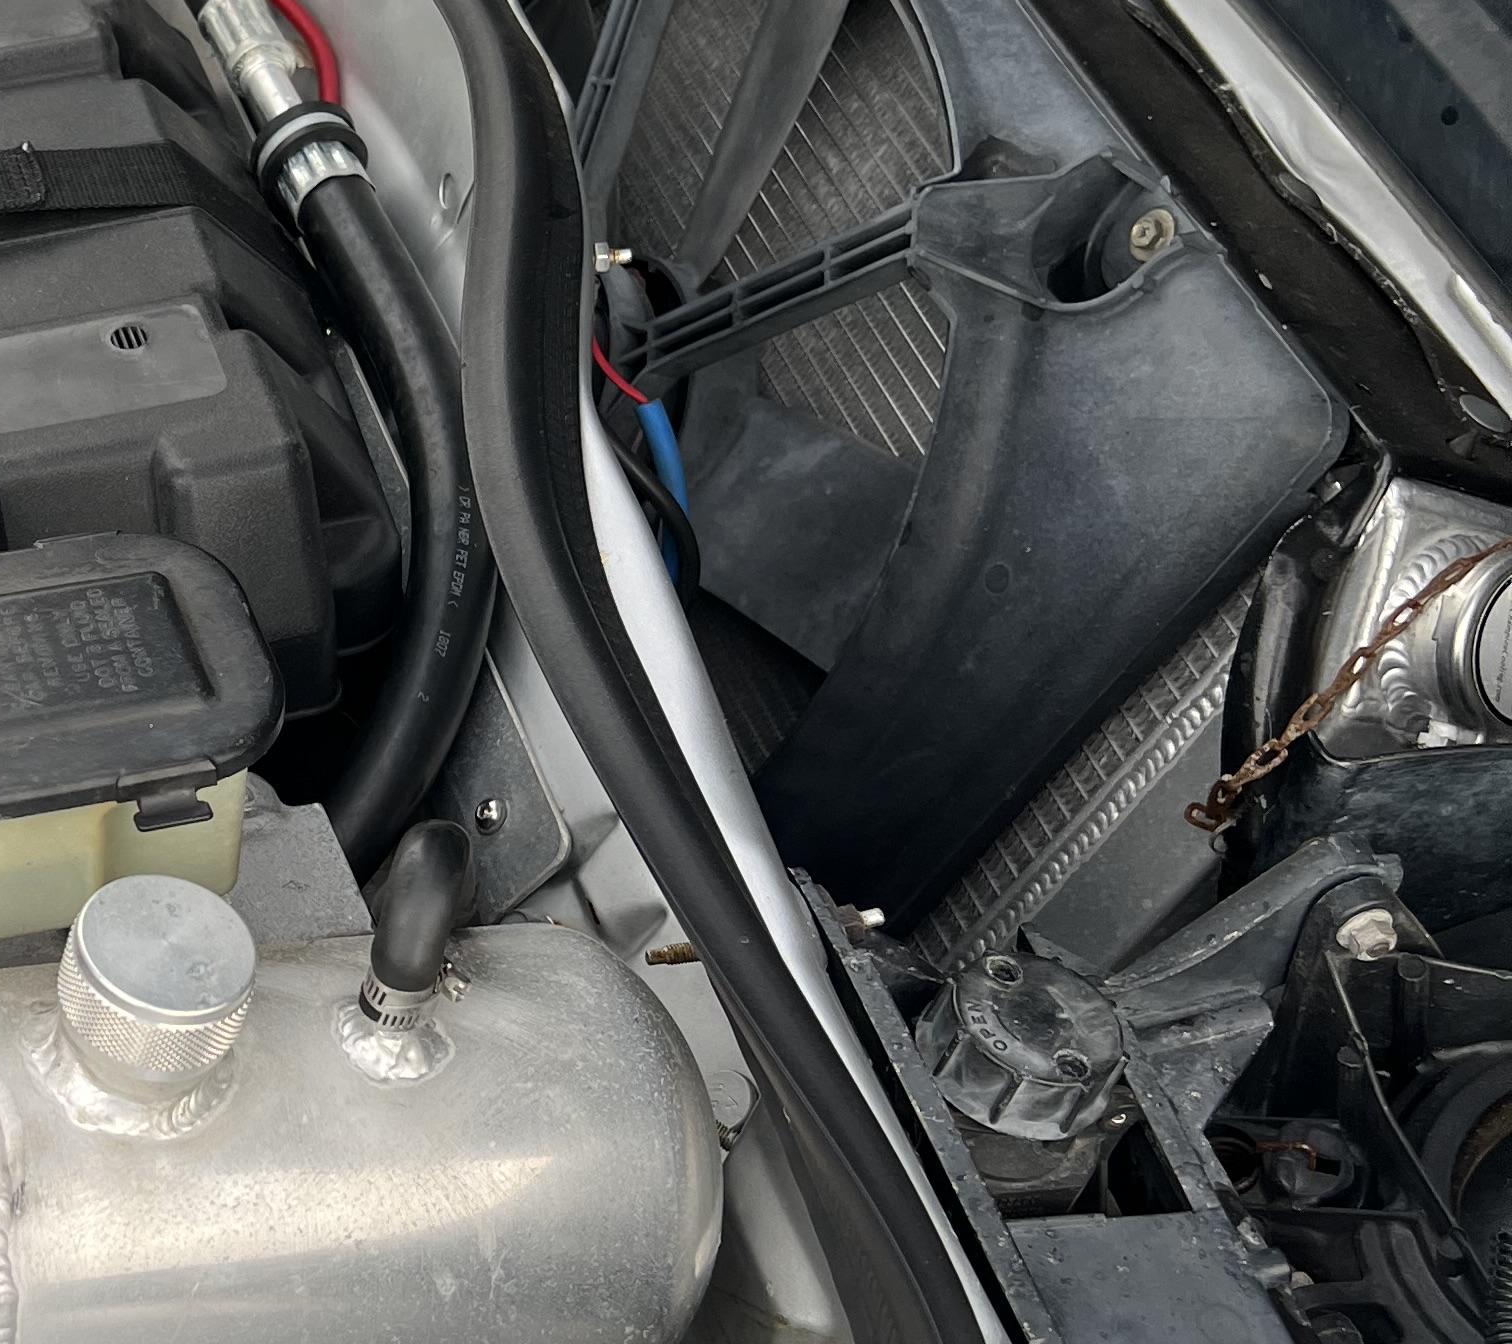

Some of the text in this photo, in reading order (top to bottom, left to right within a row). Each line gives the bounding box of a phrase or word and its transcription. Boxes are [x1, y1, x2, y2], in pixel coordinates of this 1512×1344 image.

[455, 548, 469, 568] PET
[450, 570, 465, 597] EPDM
[86, 588, 120, 639] SEALED
[91, 658, 117, 689] DOT
[112, 654, 139, 693] FROM
[966, 1000, 1008, 1051] OPEN
